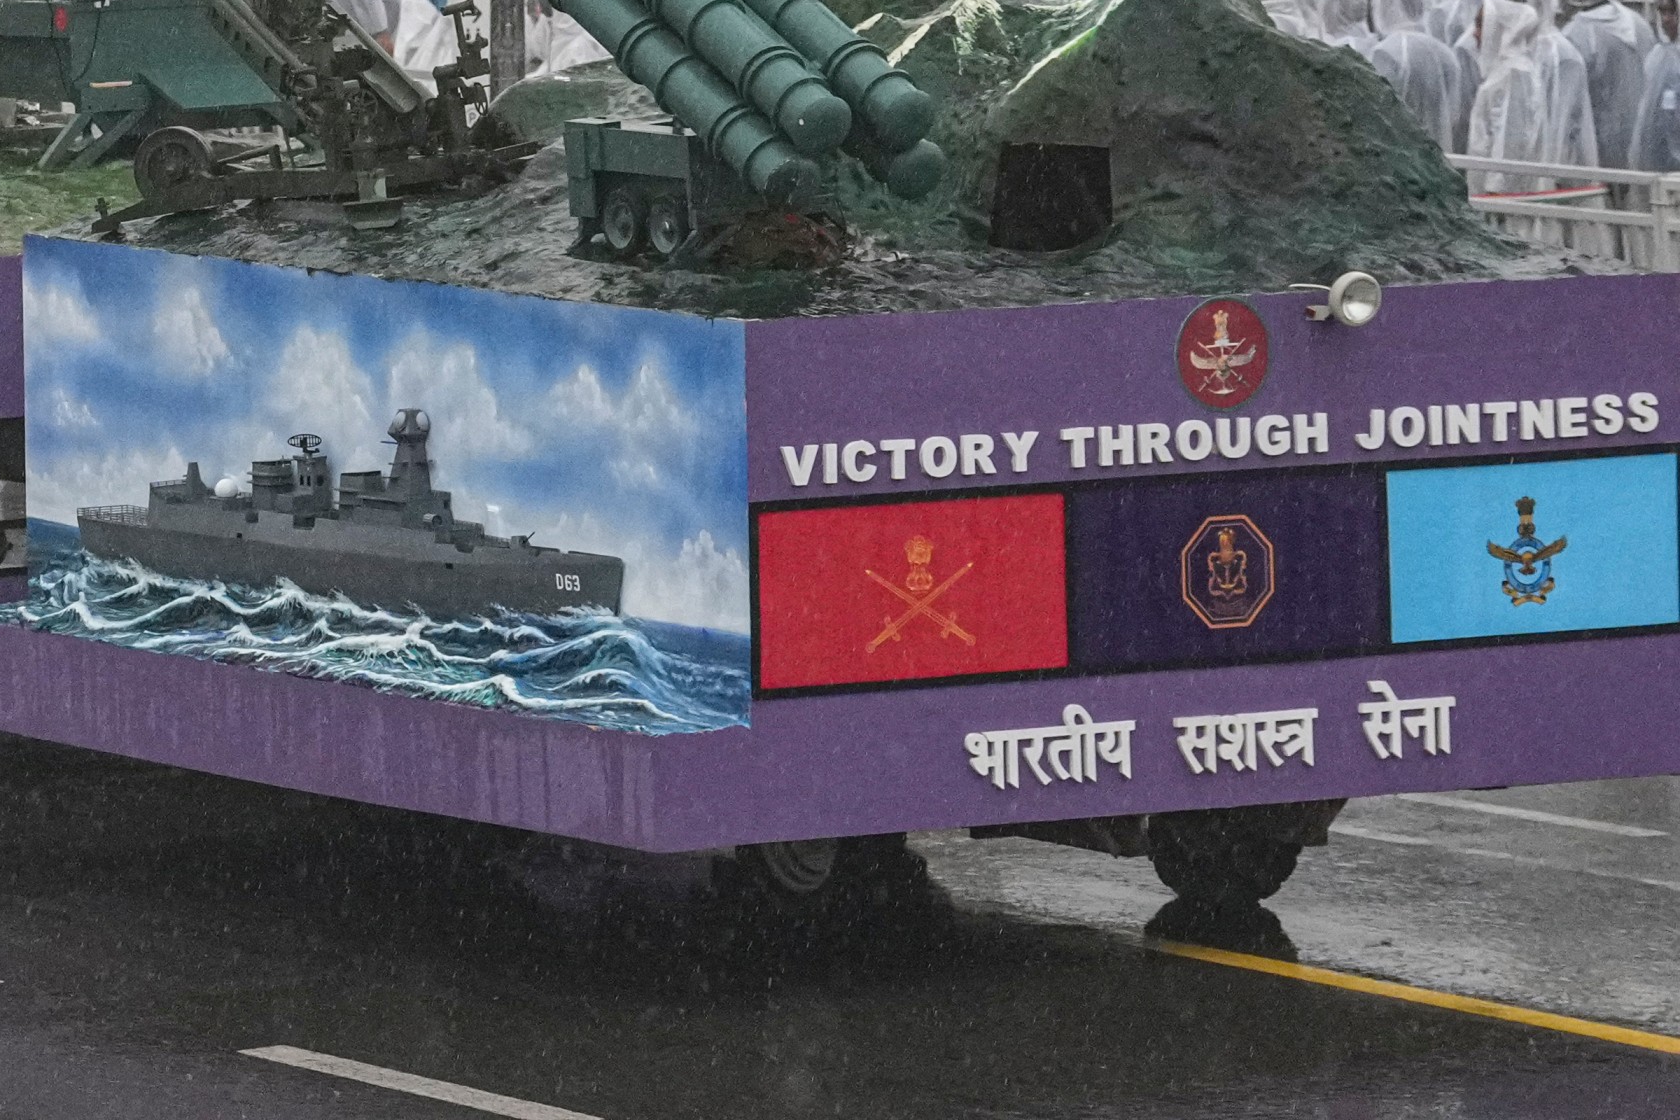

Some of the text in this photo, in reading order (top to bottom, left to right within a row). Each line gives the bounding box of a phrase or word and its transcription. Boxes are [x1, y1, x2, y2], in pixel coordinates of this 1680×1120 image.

[779, 391, 1660, 486] VICTORY THROUGH JOINTNESS
[555, 572, 581, 592] D63
[964, 679, 1457, 791] भारतीय सशस्त्र सेना
